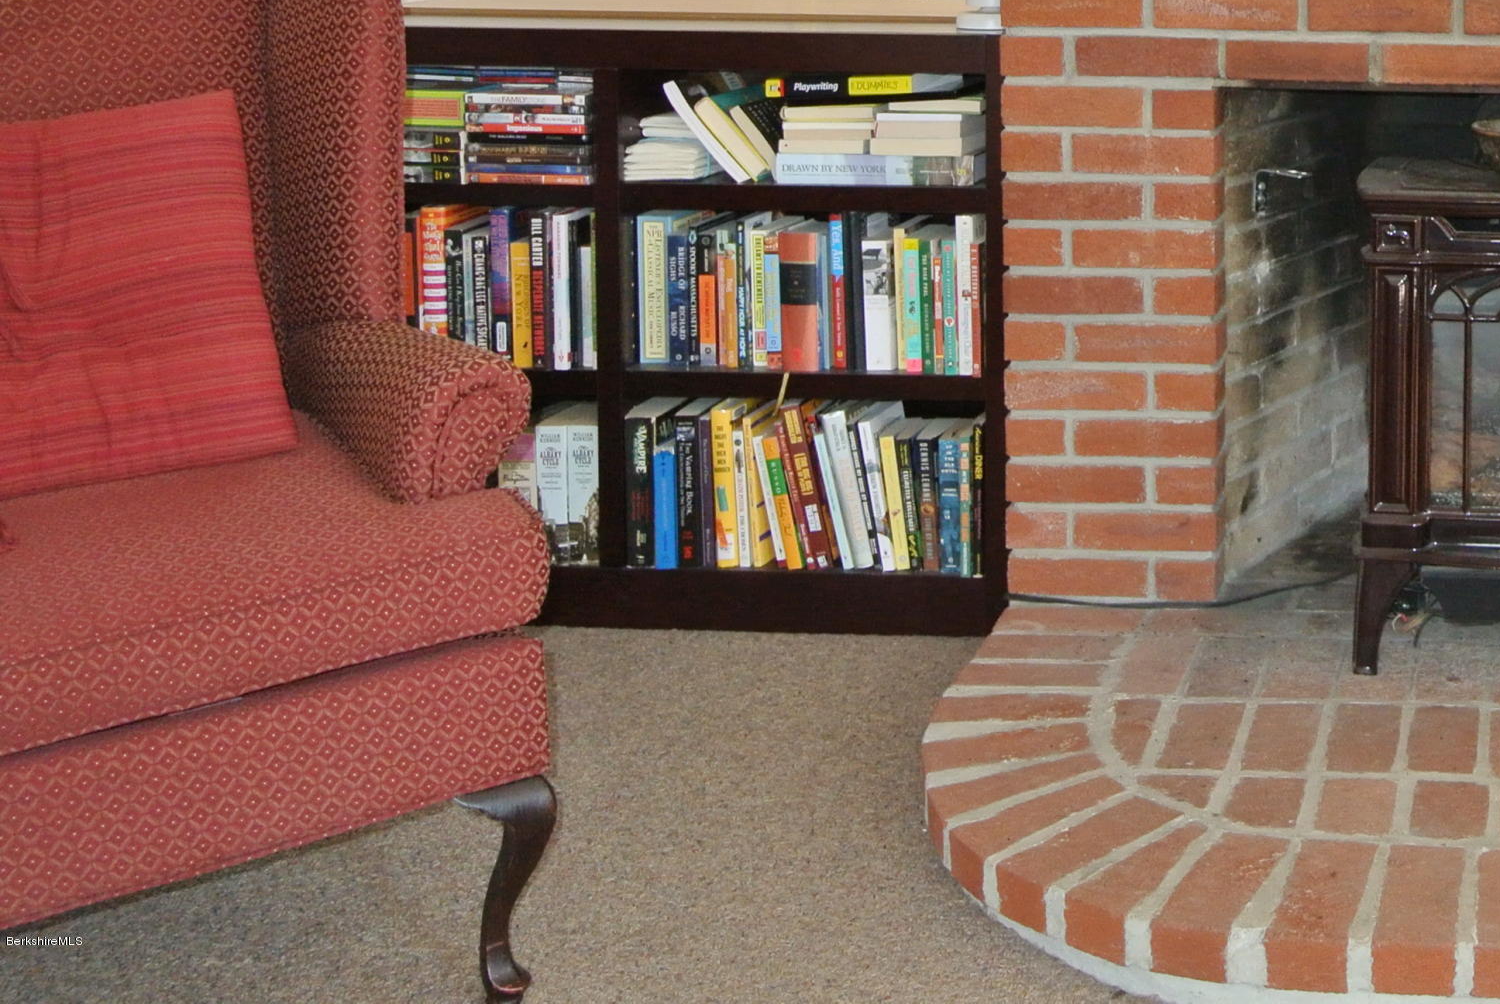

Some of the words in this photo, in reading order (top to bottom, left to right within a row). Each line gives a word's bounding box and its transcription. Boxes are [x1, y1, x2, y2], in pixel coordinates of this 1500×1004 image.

[793, 82, 839, 92] Playwriting
[856, 81, 898, 91] DUMMIES
[782, 164, 819, 173] DRAWN
[821, 164, 834, 173] BY
[835, 164, 858, 173] NEW
[859, 164, 886, 174] YORK
[531, 218, 543, 235] BILL
[646, 229, 662, 237] NPR
[532, 238, 543, 266] CARTER
[689, 246, 697, 275] SPOOKY
[832, 249, 843, 271] And
[516, 274, 525, 296] NEW
[532, 270, 544, 314] DESPERATE
[678, 279, 686, 290] OF
[516, 302, 525, 329] YORK
[648, 292, 656, 319] MUSIC
[656, 288, 664, 348] ENCYCLOPEDIA
[533, 316, 545, 356] NETWORKS
[635, 429, 647, 474] VAMPIRE
[974, 427, 982, 453] American
[919, 442, 929, 470] DENNIS
[685, 455, 693, 488] VAMPIRE
[770, 461, 782, 494] RUSSO
[922, 473, 931, 502] LEHANE
[686, 491, 694, 516] BOOK
